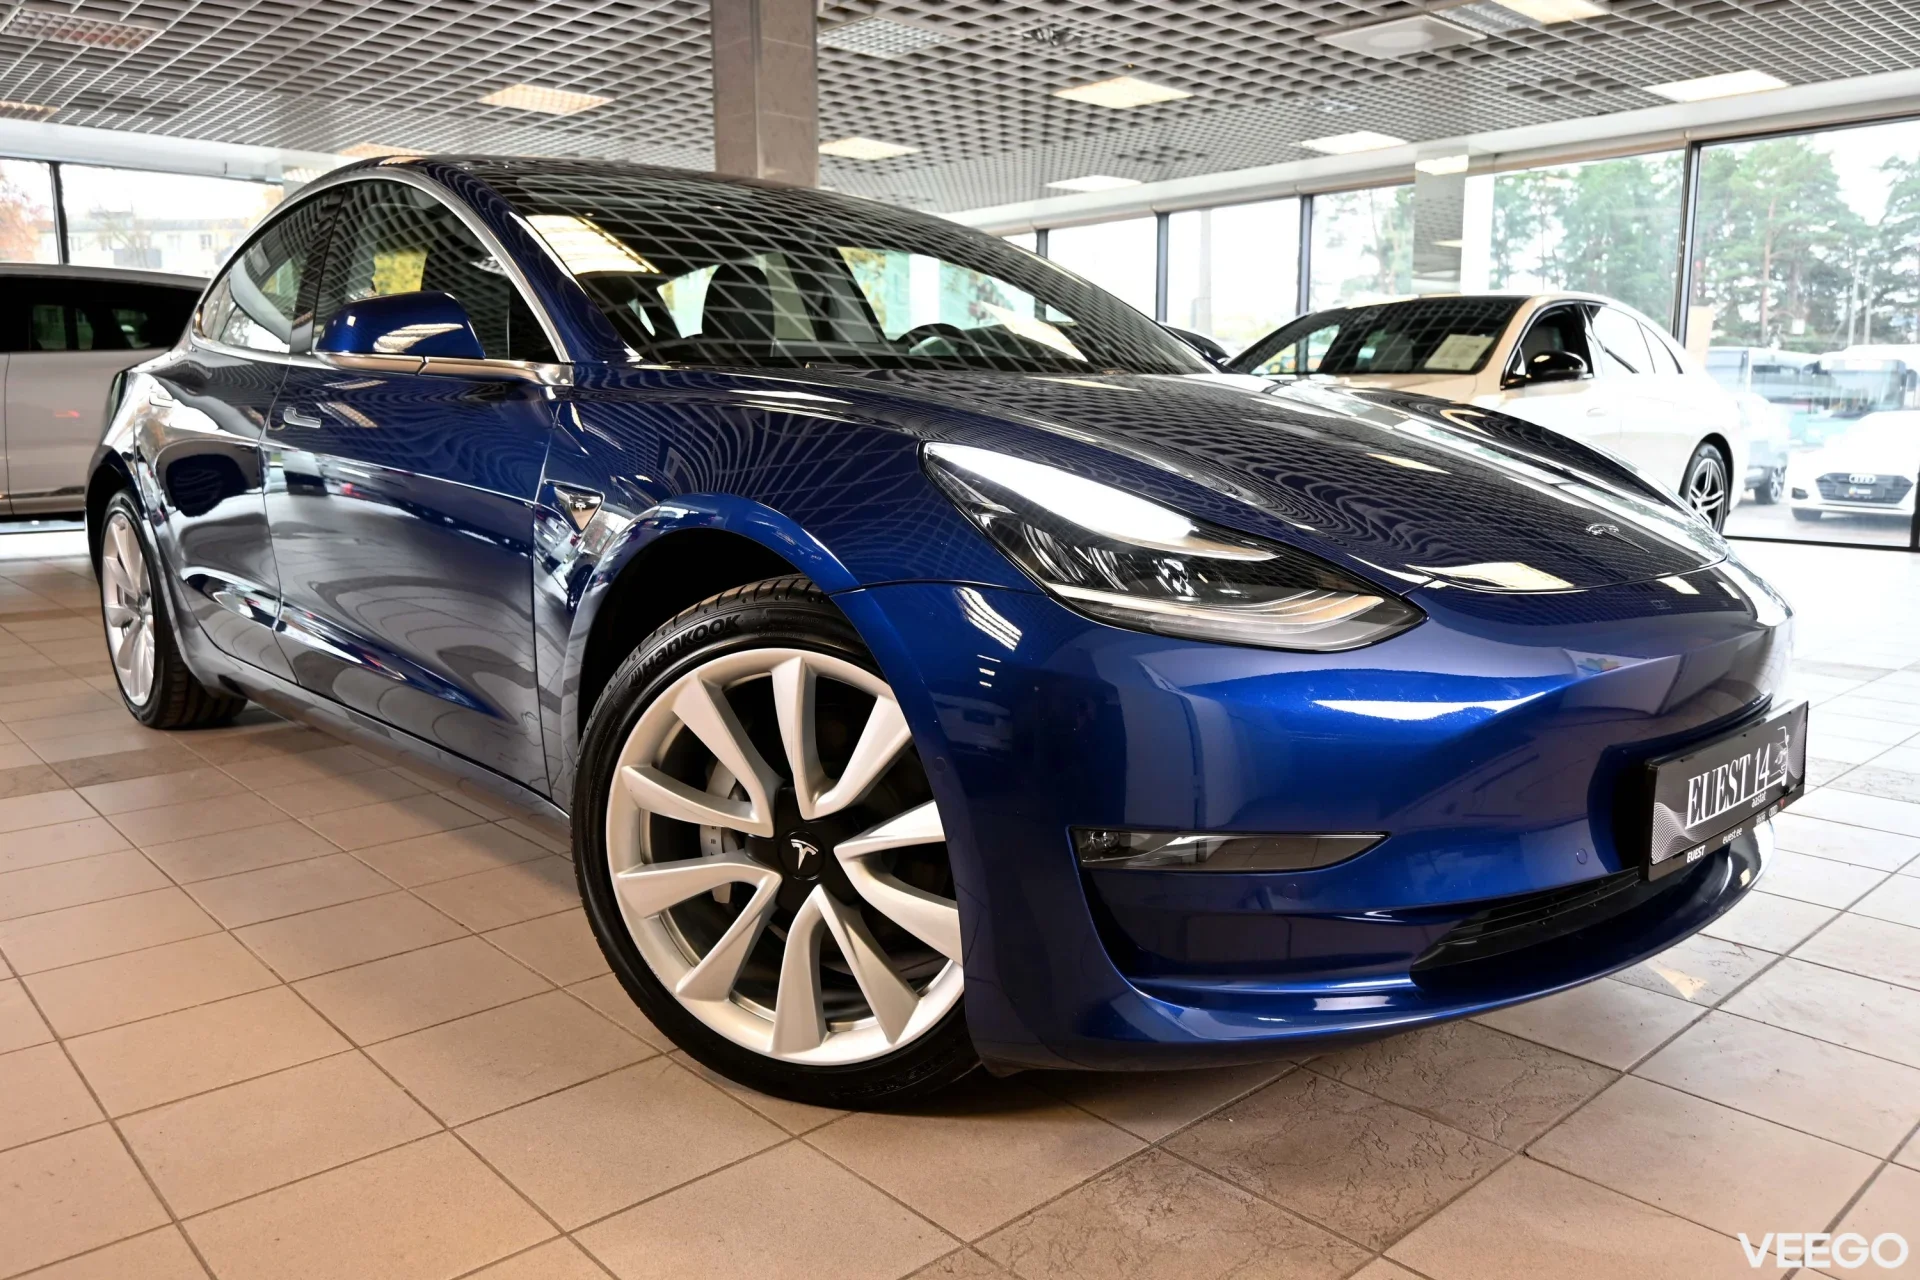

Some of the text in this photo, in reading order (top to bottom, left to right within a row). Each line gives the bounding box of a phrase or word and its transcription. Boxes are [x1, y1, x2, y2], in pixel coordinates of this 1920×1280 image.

[1686, 742, 1770, 828] EUEST 14
[1686, 845, 1706, 863] EUEST
